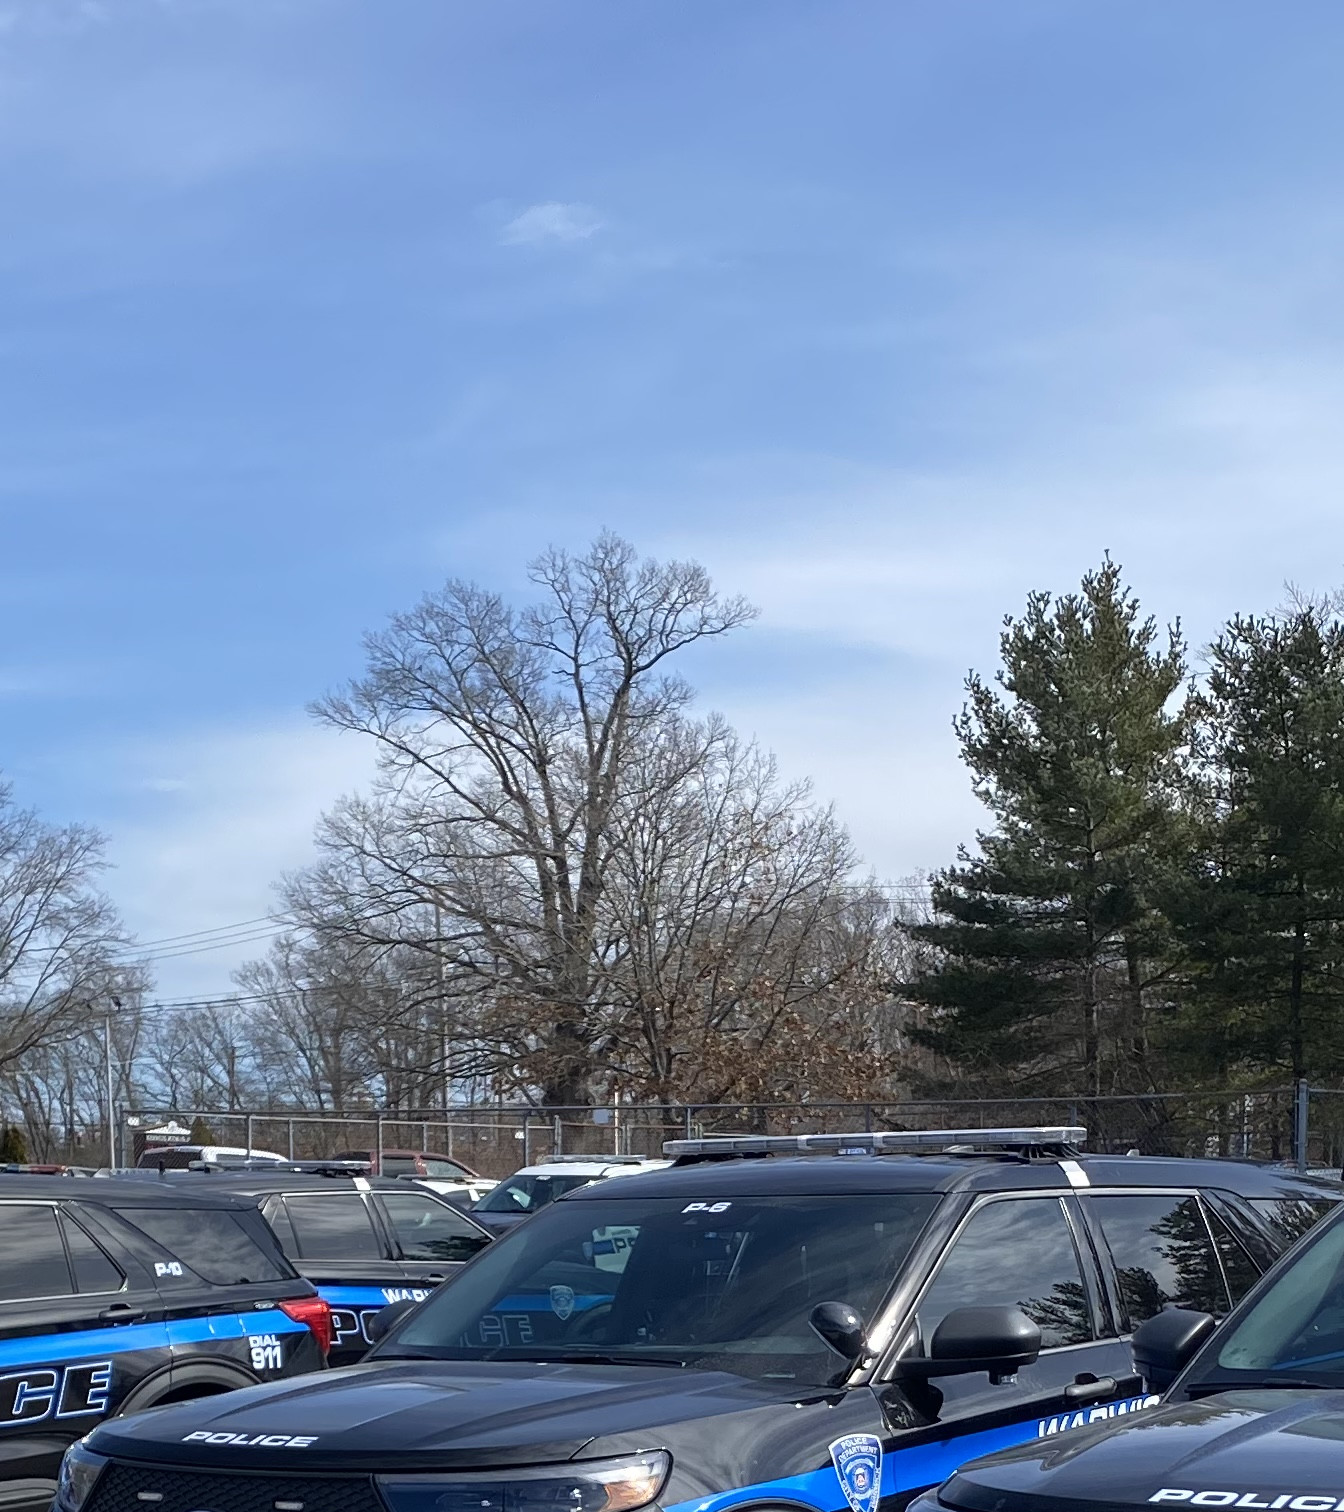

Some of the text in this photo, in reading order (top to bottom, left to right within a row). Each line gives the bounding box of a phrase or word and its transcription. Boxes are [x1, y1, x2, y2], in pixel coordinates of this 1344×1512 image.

[680, 1202, 732, 1213] P-6
[154, 1262, 182, 1277] P-10
[249, 1334, 280, 1348] DIAL
[251, 1347, 282, 1369] 911
[181, 1431, 319, 1447] POLICE
